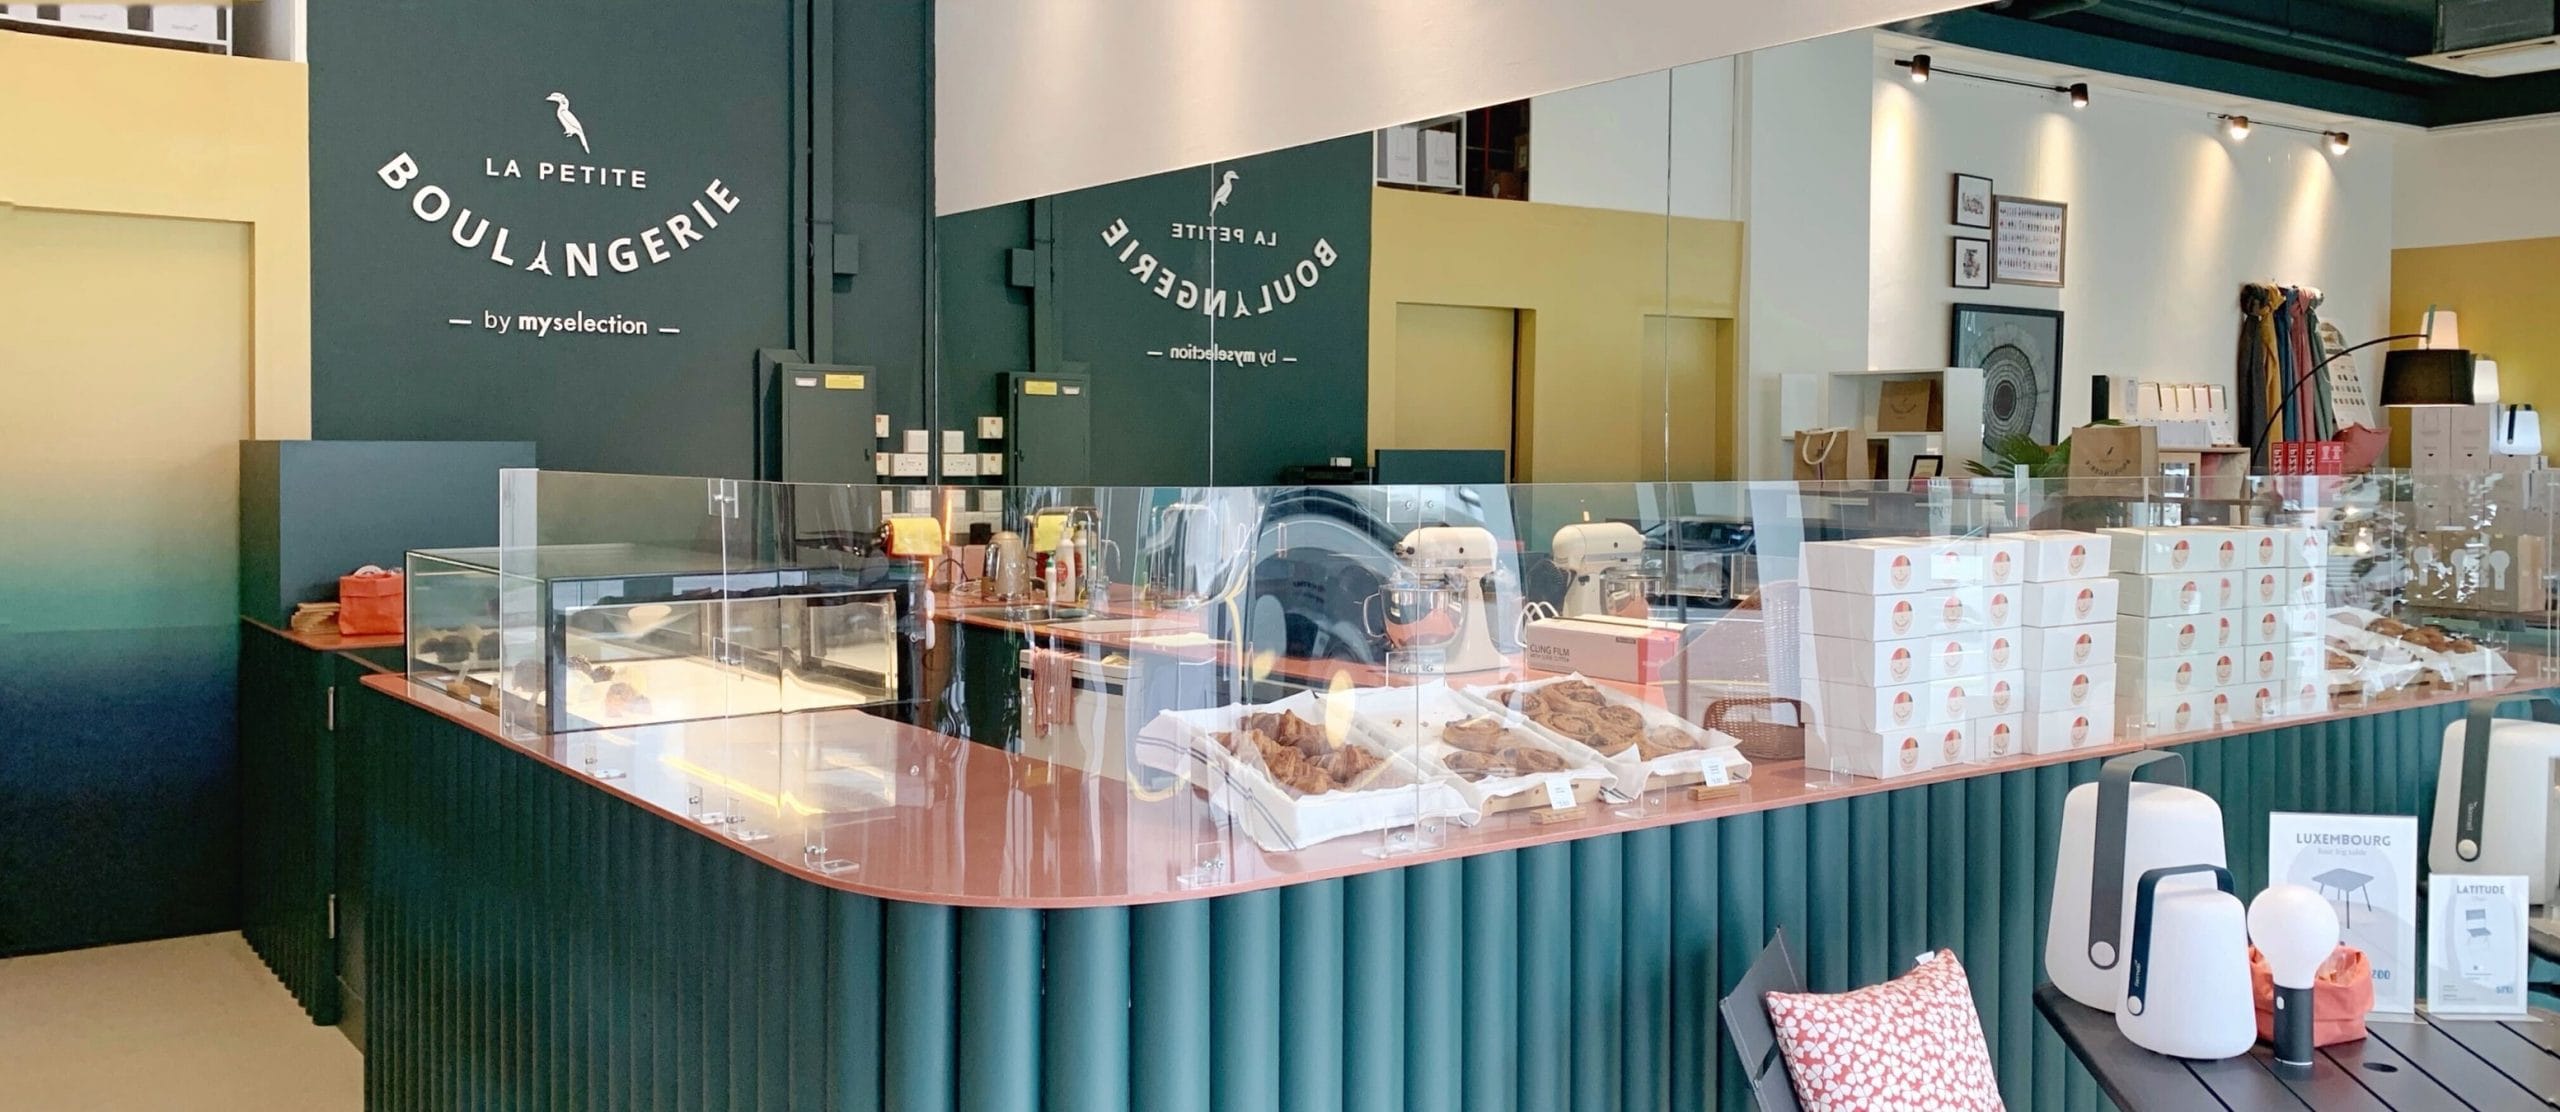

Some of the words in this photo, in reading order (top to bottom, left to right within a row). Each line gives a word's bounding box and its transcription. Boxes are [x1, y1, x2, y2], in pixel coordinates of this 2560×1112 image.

[486, 157, 521, 178] LA
[539, 162, 647, 189] PETITE
[377, 151, 741, 278] BOULANGERIE
[484, 310, 511, 334] by
[518, 311, 648, 337] myselection
[1553, 647, 1570, 657] FILM
[2296, 833, 2391, 847] LUXEMBOURG
[2456, 885, 2505, 895] LATITUDE
